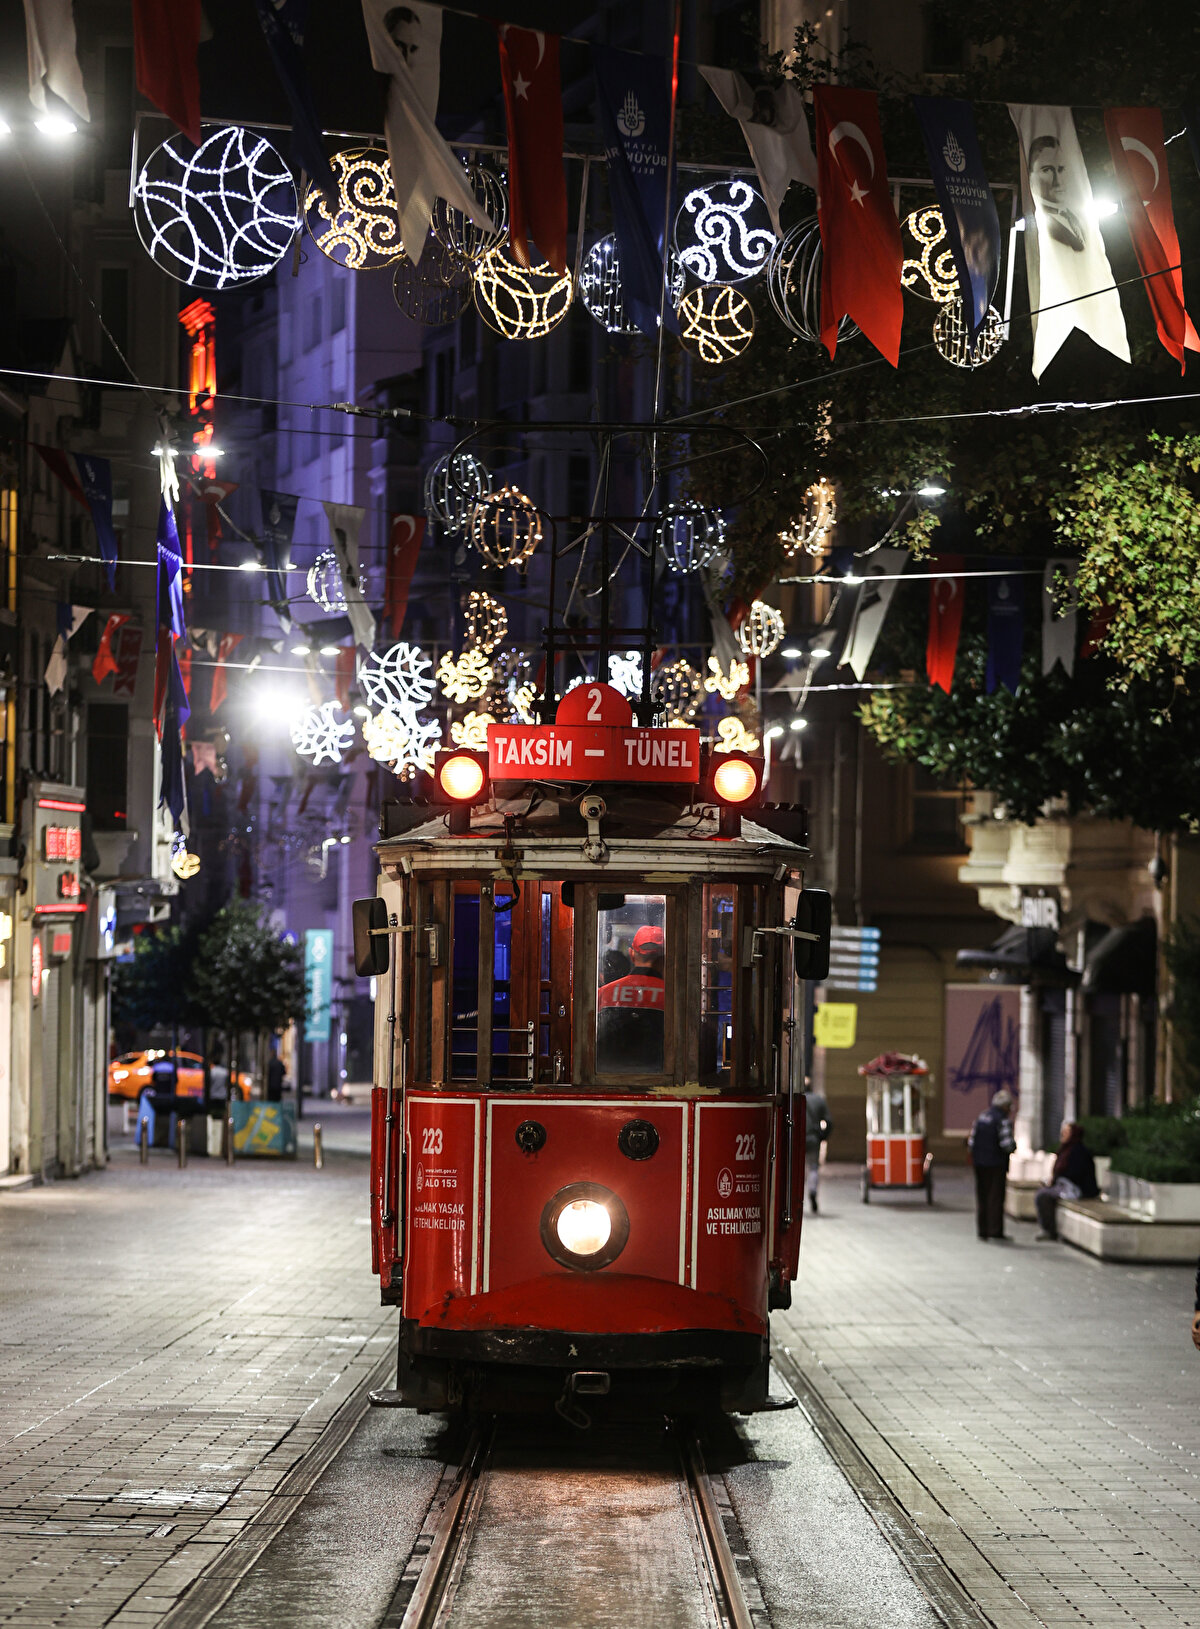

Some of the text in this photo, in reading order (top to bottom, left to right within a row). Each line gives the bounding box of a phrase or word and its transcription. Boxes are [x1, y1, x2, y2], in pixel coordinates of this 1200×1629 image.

[587, 688, 602, 721] 2
[494, 732, 573, 767] TAKSİM
[624, 732, 693, 768] TÜNEL
[422, 1128, 443, 1155] 223
[735, 1134, 756, 1161] 223
[425, 1179, 440, 1188] ALO
[441, 1179, 457, 1188] 153
[735, 1184, 760, 1193] ALO 153
[438, 1202, 465, 1215] YASAK
[707, 1207, 744, 1220] ASILMAK
[418, 1216, 466, 1231] TEHLİKELİDİR
[706, 1222, 718, 1235] VE
